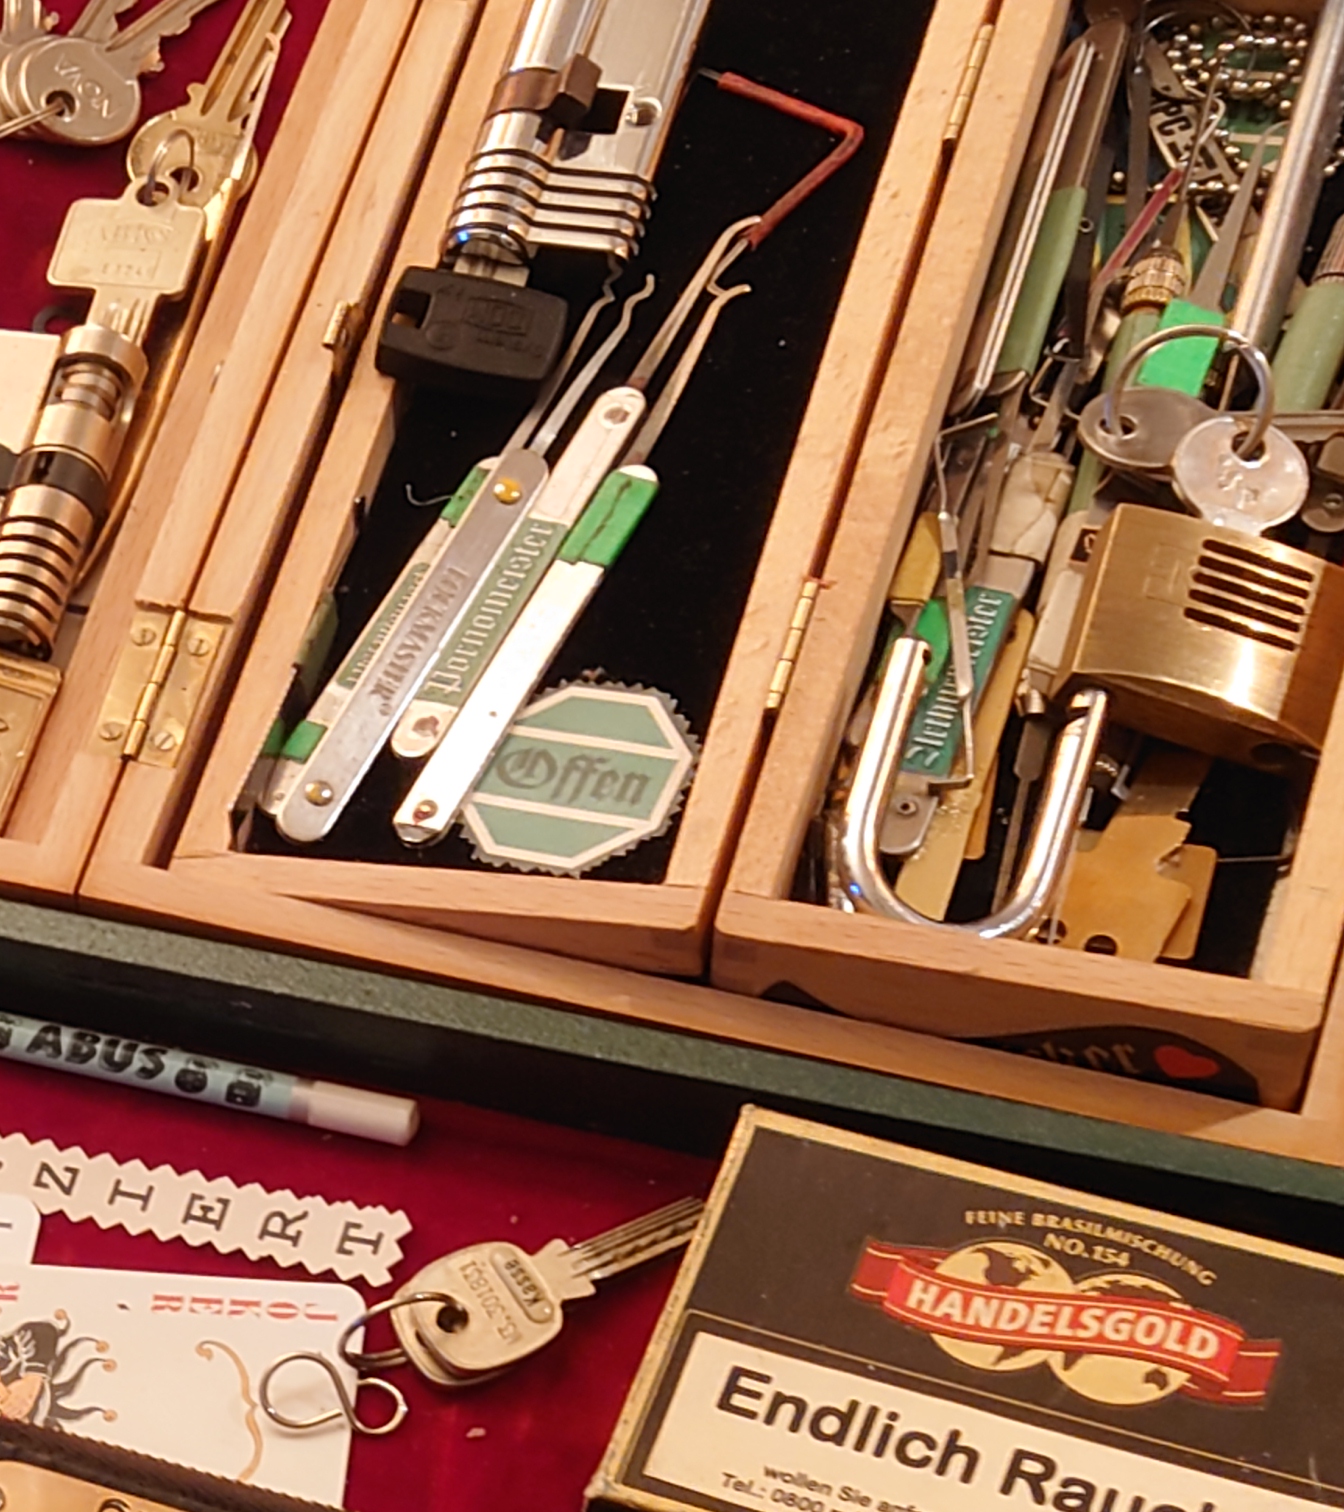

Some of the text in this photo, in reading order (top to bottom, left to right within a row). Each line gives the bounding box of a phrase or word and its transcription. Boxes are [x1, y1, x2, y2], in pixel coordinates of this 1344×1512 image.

[54, 56, 116, 121] NOVA
[499, 745, 650, 809] Offen
[25, 1024, 172, 1081] ABUS
[965, 1209, 1218, 1286] FEINE BRASILMISCHUNG
[150, 1292, 339, 1323] JOKER
[504, 1256, 548, 1305] Kasse
[906, 1278, 1220, 1362] HANDELSGOLD
[715, 1364, 981, 1485] Endlich
[762, 1463, 833, 1500] wollen
[837, 1483, 872, 1507] Sie
